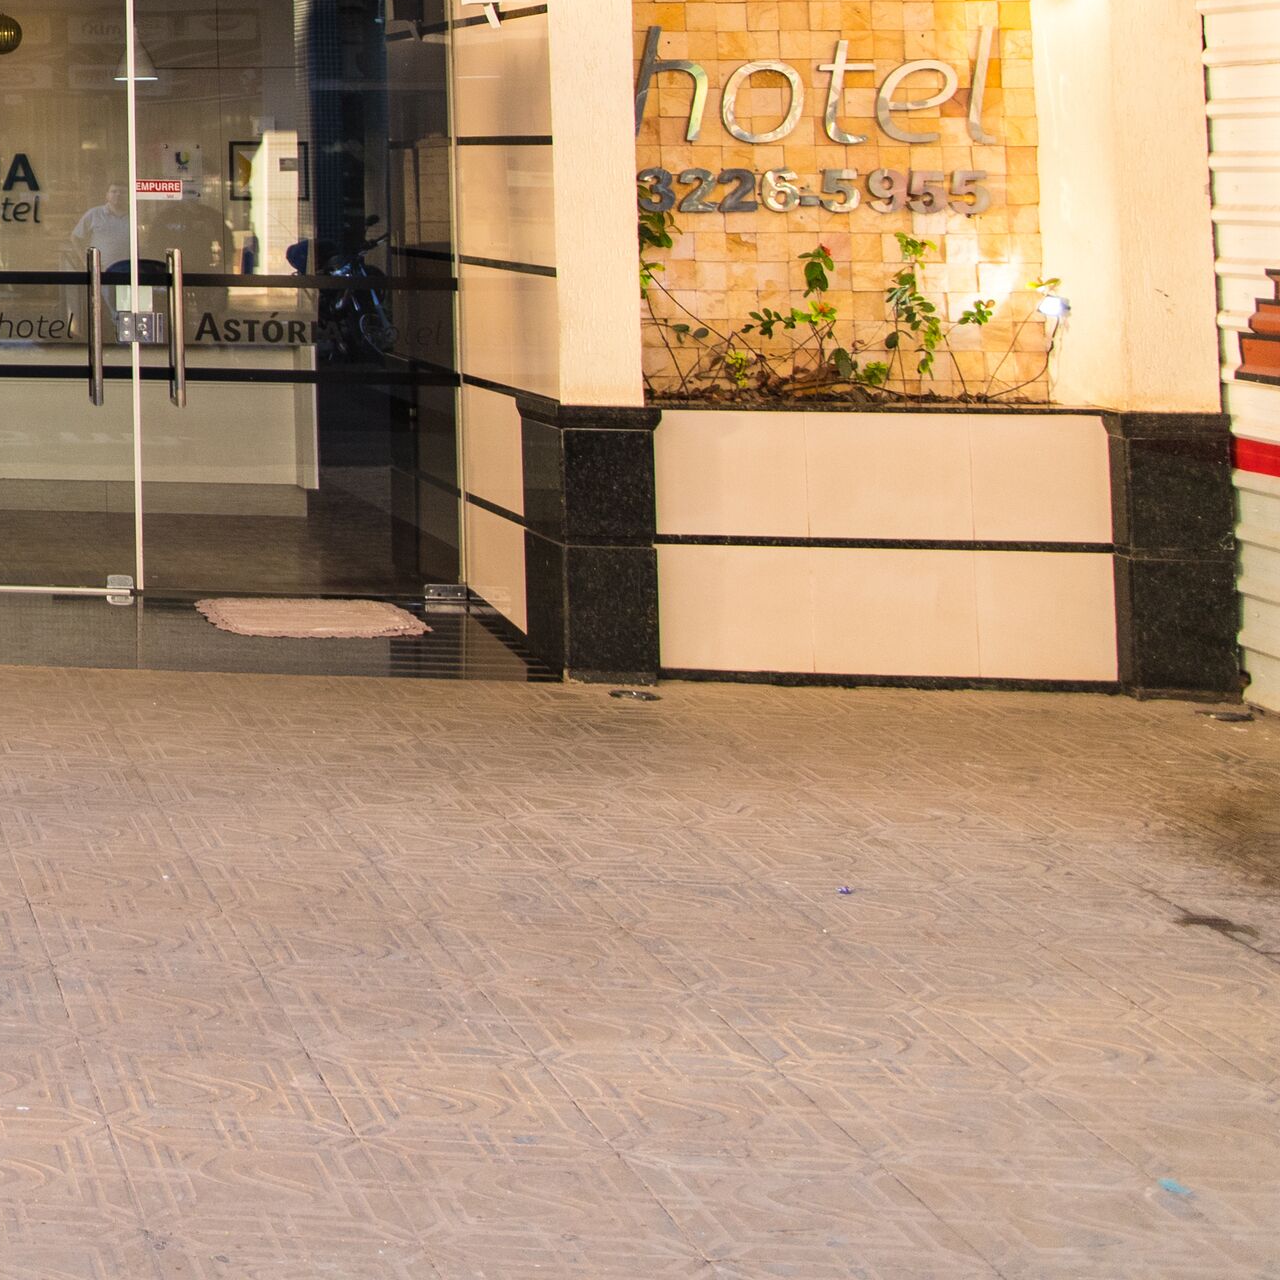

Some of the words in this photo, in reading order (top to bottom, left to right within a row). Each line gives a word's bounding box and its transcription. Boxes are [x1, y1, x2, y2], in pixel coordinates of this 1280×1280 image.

[635, 25, 997, 144] hotel
[136, 182, 180, 191] EMPURRE
[637, 167, 992, 214] 3226-5955
